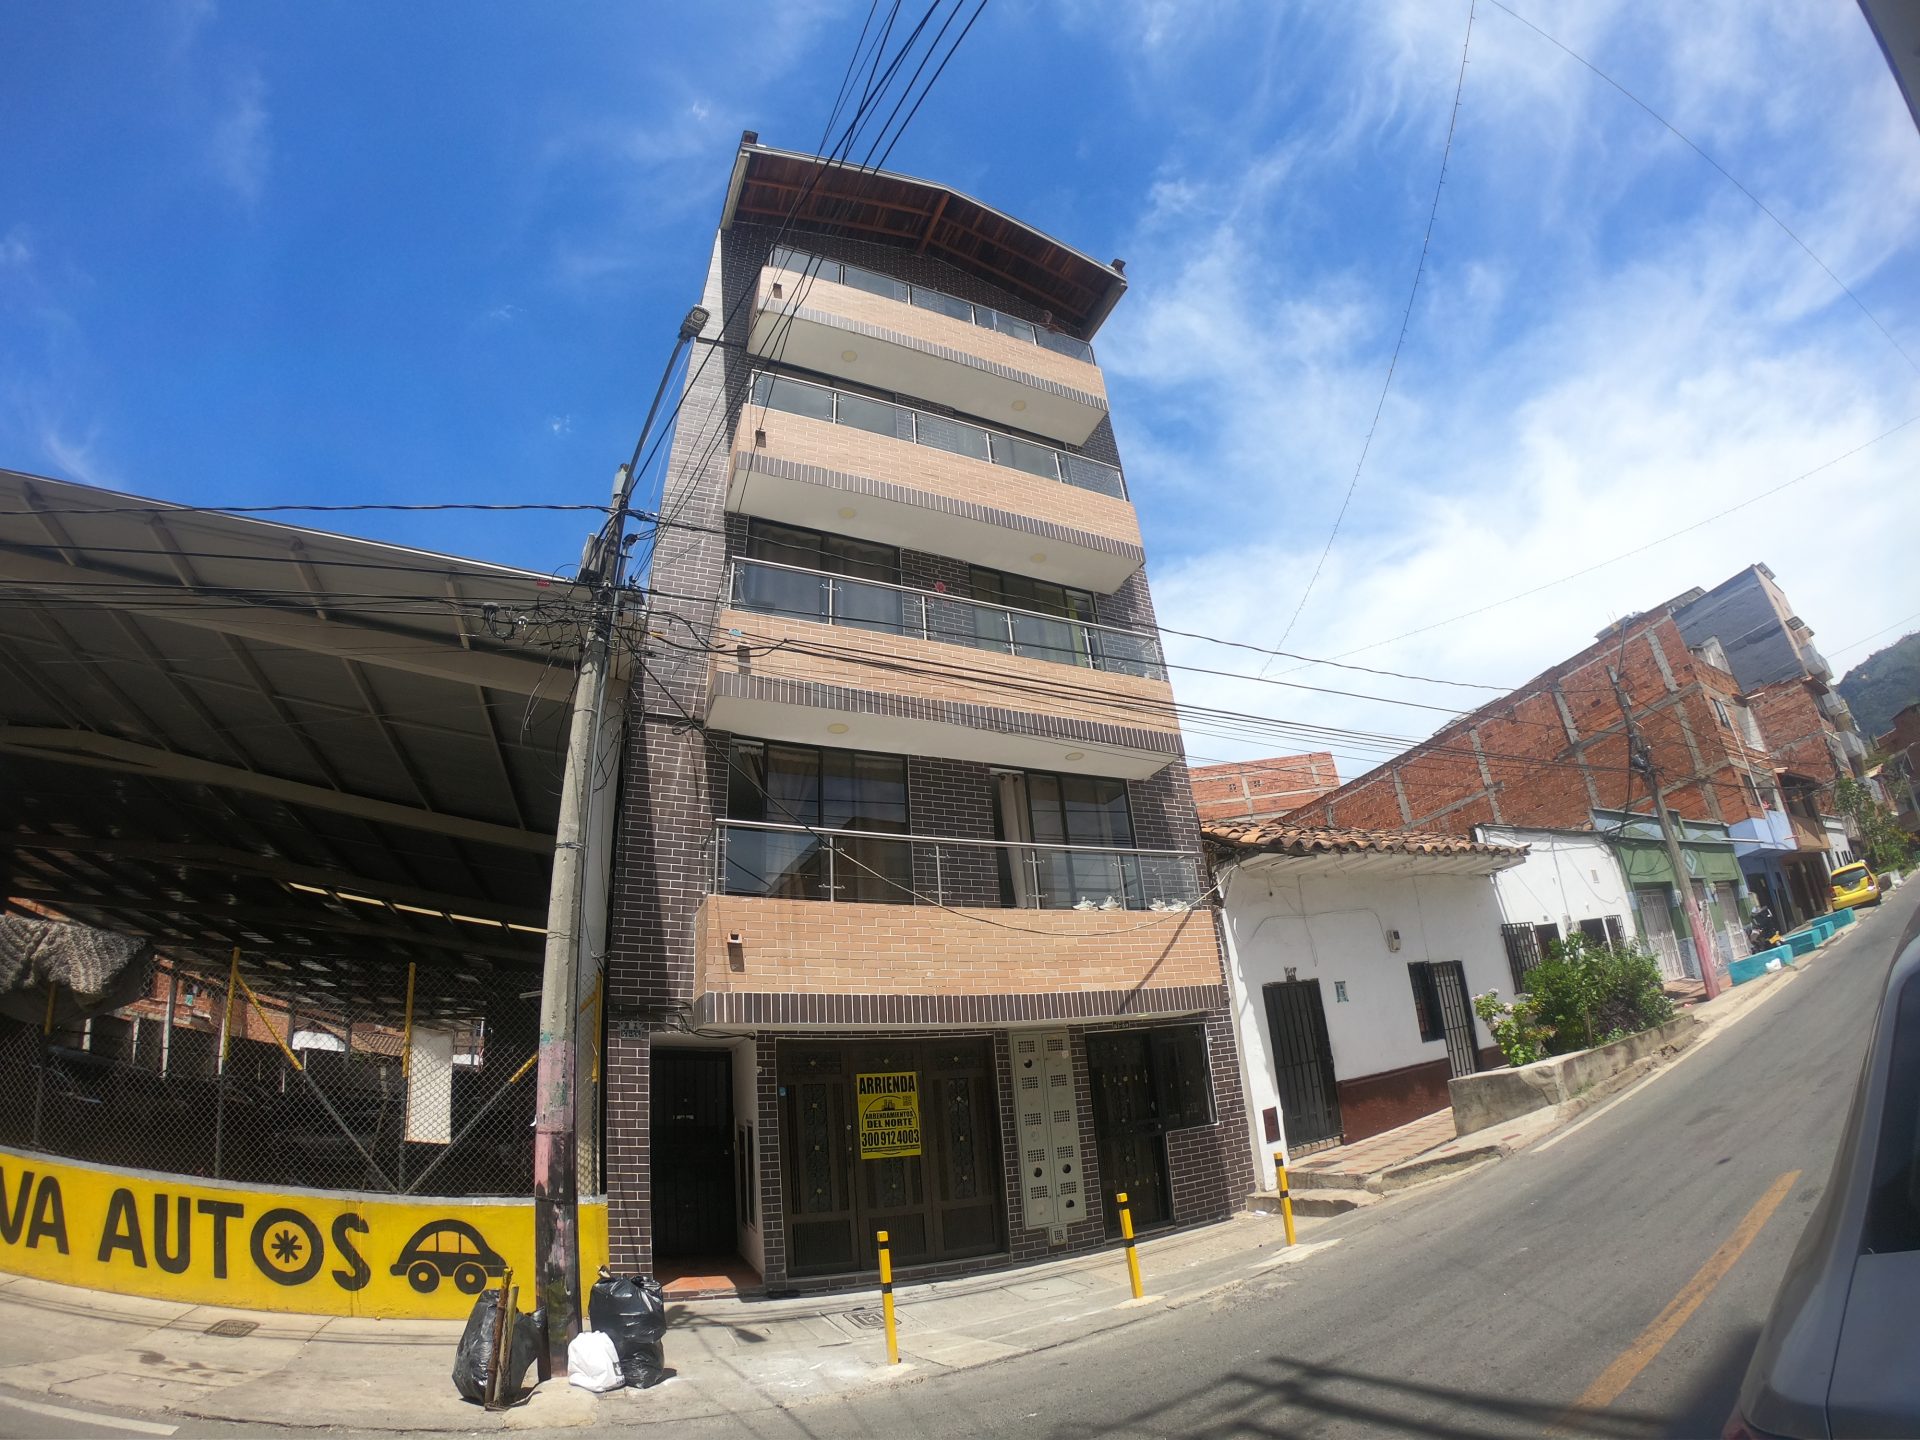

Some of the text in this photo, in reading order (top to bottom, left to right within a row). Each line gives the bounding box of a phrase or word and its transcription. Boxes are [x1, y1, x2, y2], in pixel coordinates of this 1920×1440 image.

[859, 1075, 915, 1094] ARRIENDA
[865, 1110, 914, 1119] ARRENDAMIENTOS
[867, 1118, 912, 1129] DEL NORTE
[97, 1188, 371, 1291] AUTOS
